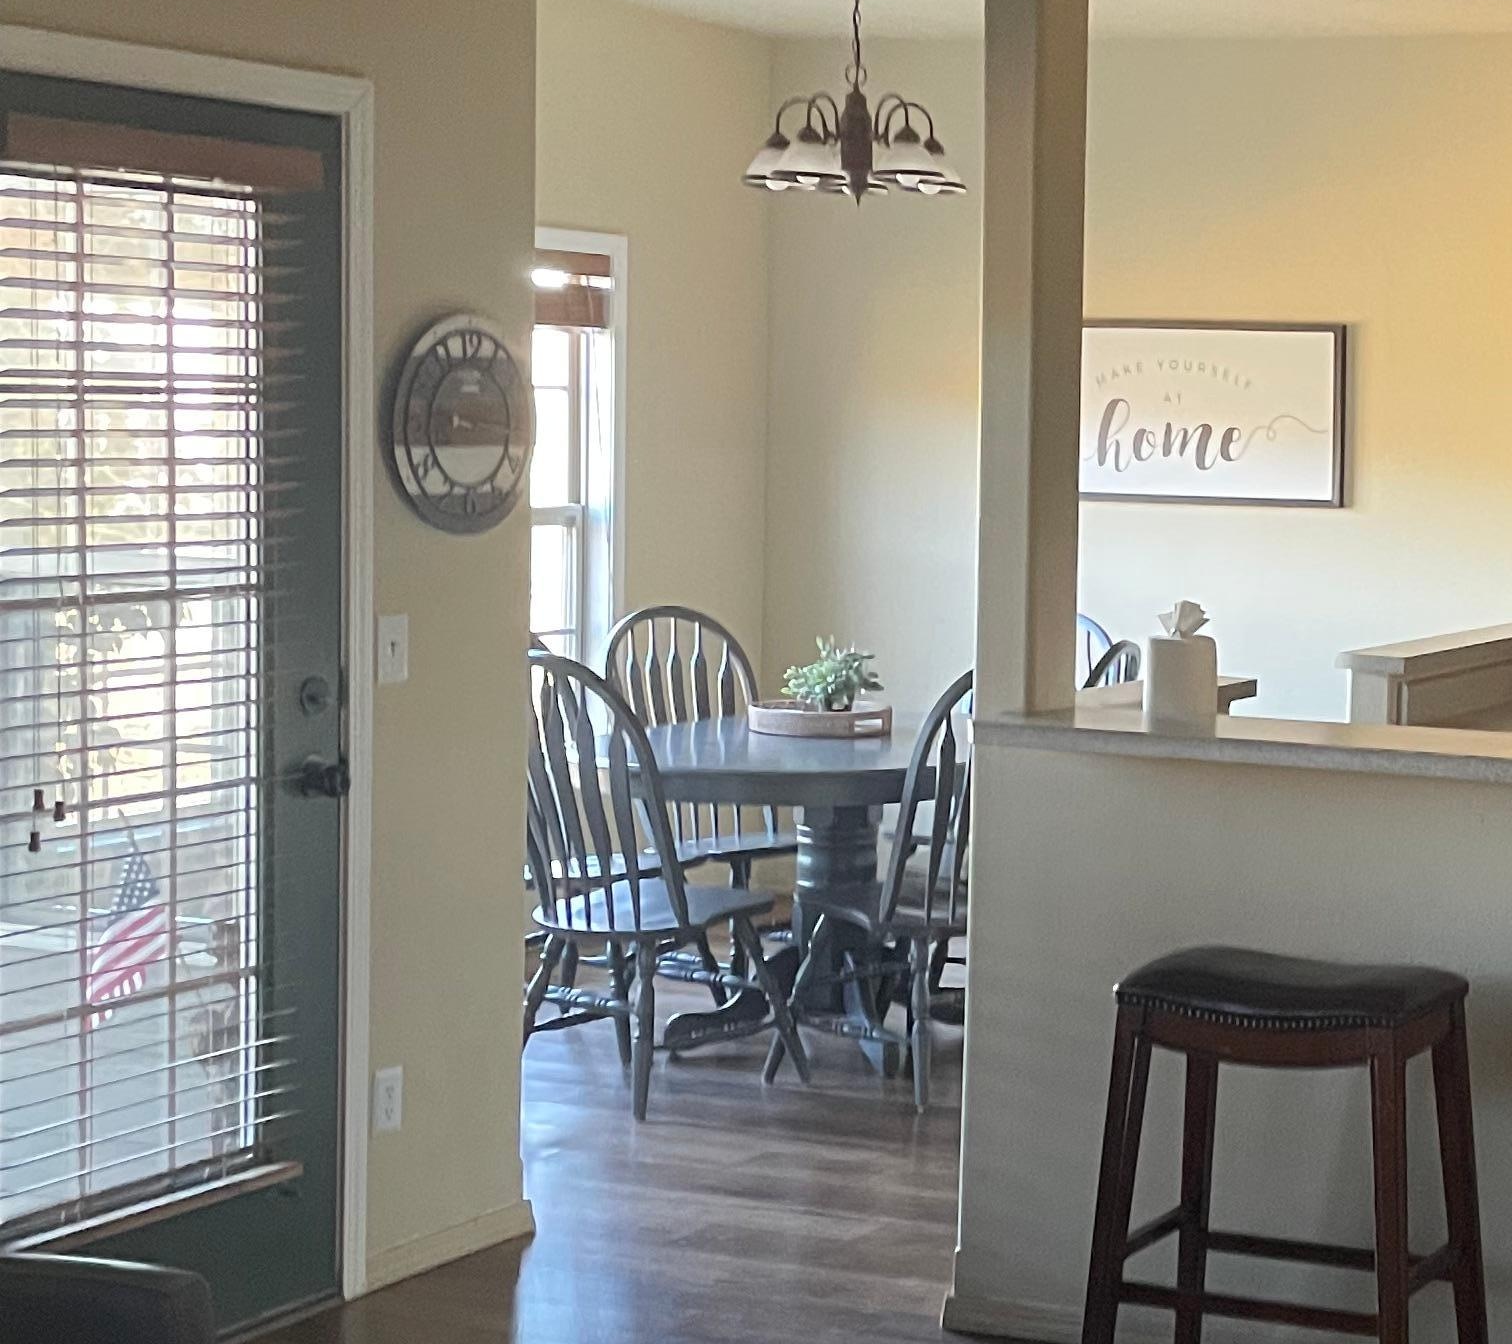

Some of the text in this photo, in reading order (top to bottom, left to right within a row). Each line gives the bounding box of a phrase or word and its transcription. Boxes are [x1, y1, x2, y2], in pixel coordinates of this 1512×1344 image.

[1096, 358, 1252, 390] MAKE YOURSELF
[1163, 392, 1182, 404] AT
[1090, 397, 1258, 472] home
